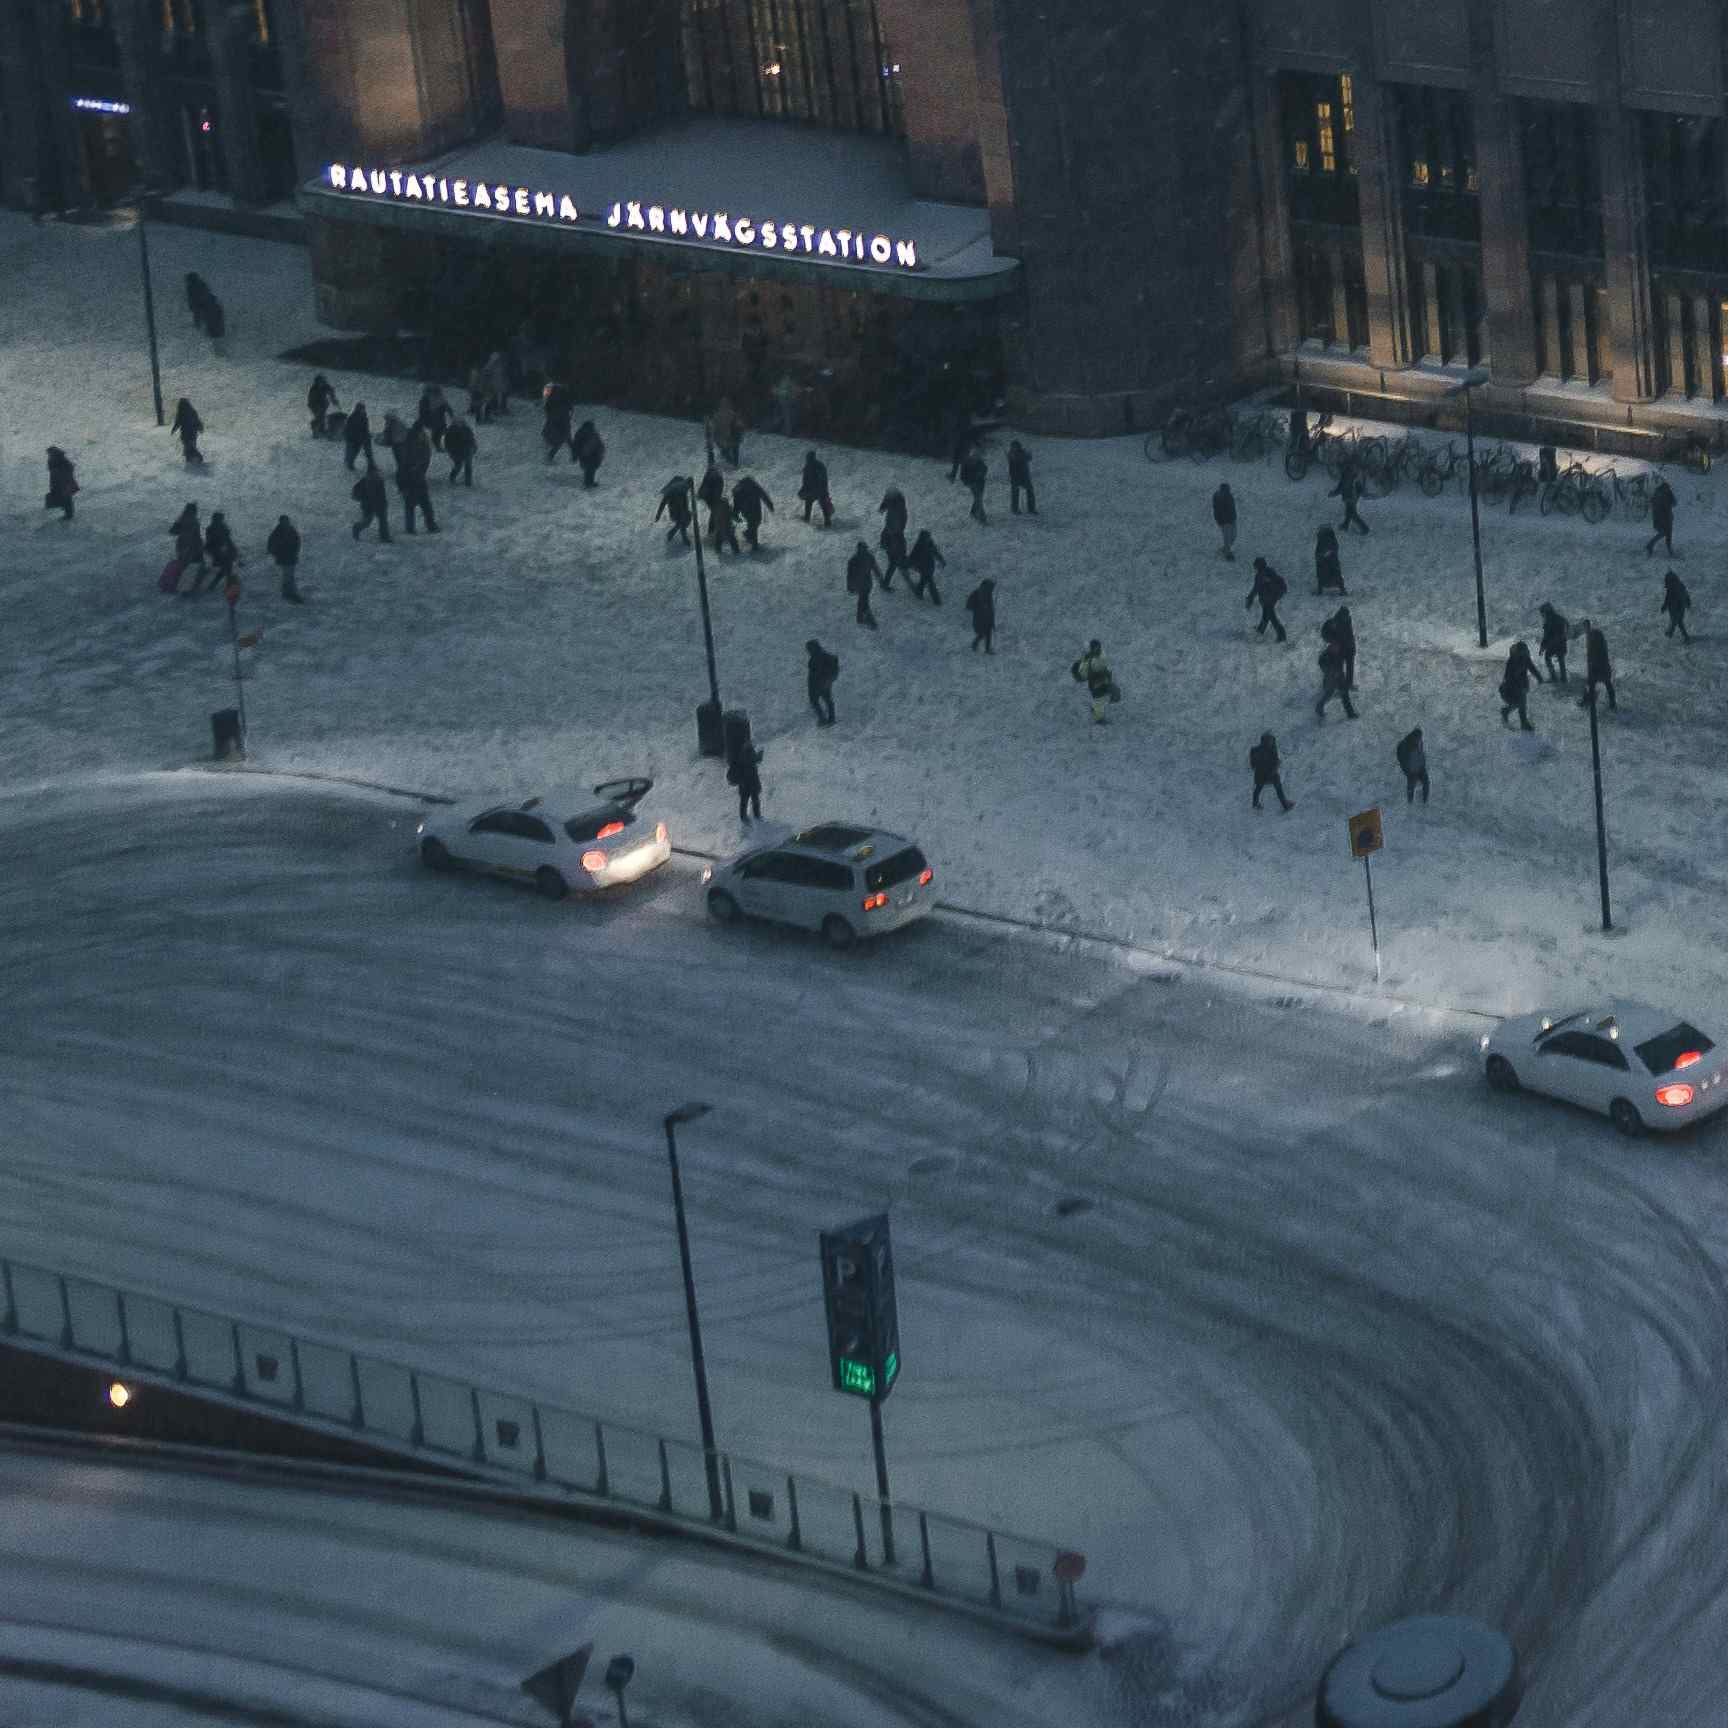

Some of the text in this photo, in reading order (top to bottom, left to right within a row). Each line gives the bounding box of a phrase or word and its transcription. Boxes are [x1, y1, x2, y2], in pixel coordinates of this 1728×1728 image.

[329, 161, 918, 267] RAUTATIEASEMA JÄRNVÄGSSTATION
[837, 1257, 856, 1285] P
